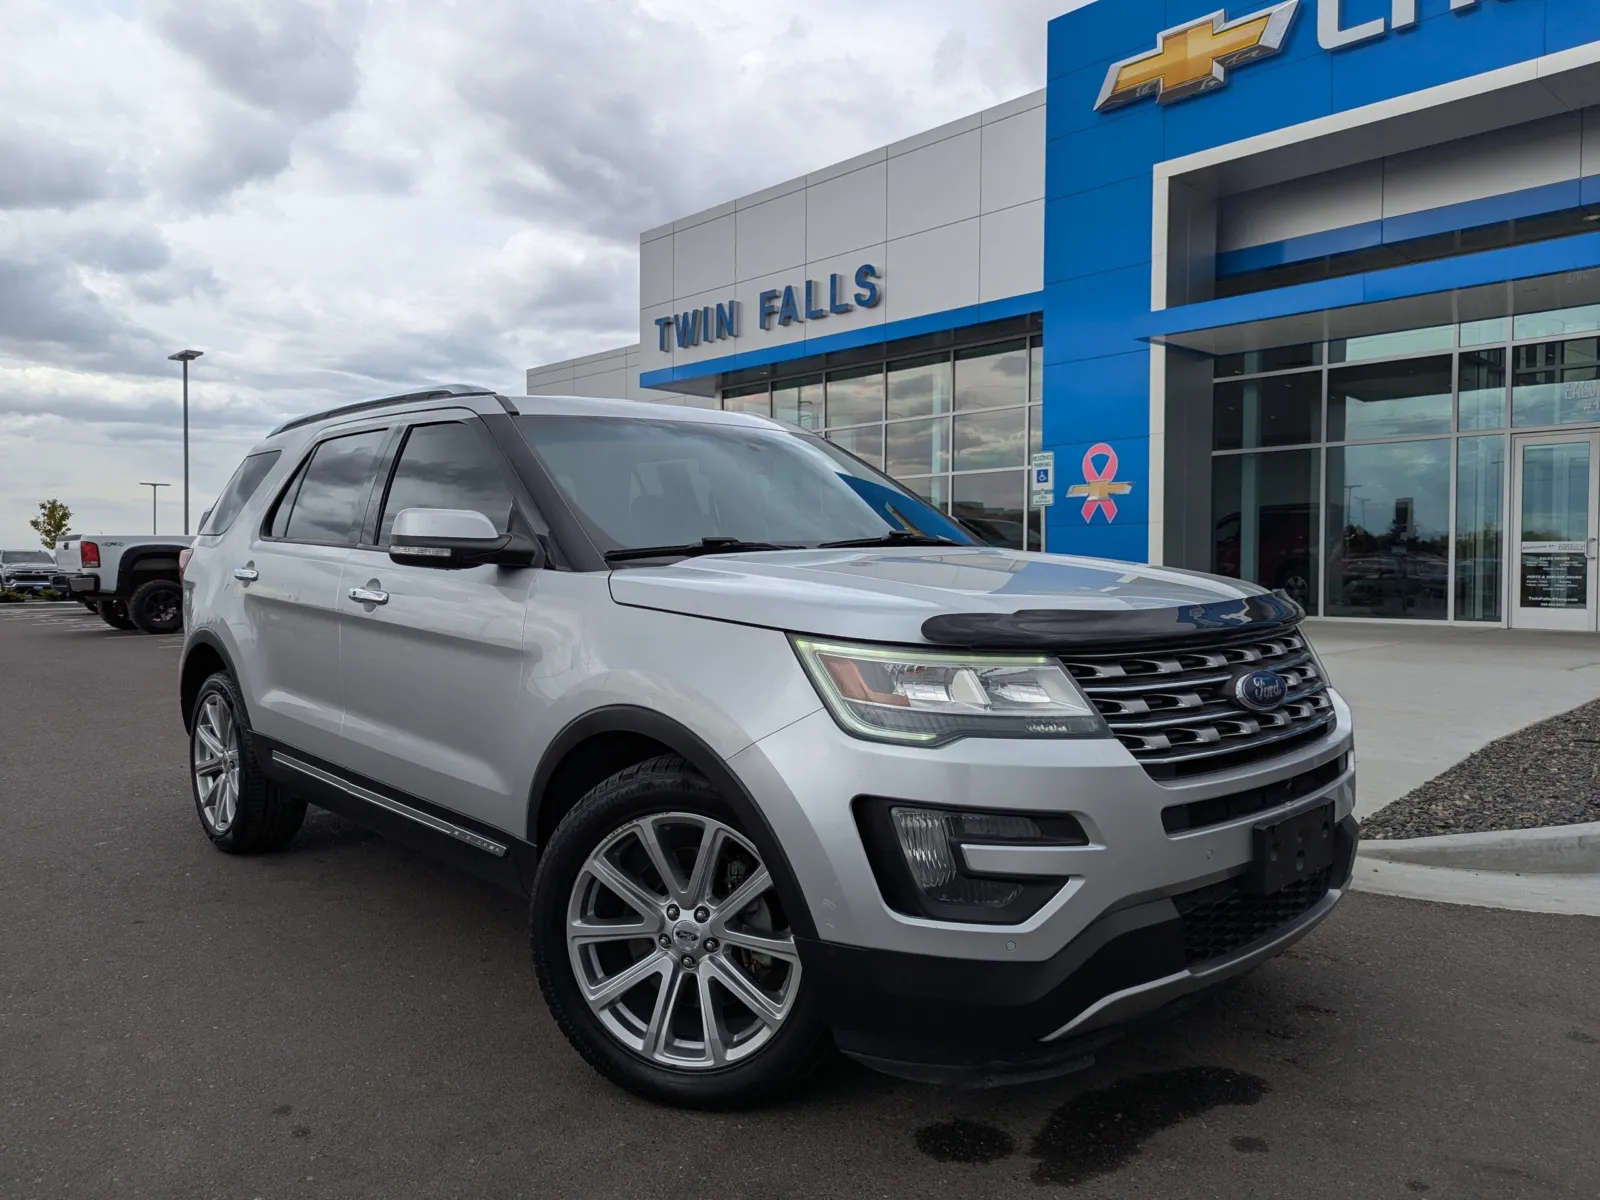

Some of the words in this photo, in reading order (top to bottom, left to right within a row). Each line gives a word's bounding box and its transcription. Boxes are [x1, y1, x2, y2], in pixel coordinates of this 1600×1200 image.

[655, 300, 740, 352] TWIN
[759, 264, 881, 331] FALLS
[1253, 676, 1282, 700] Ford
